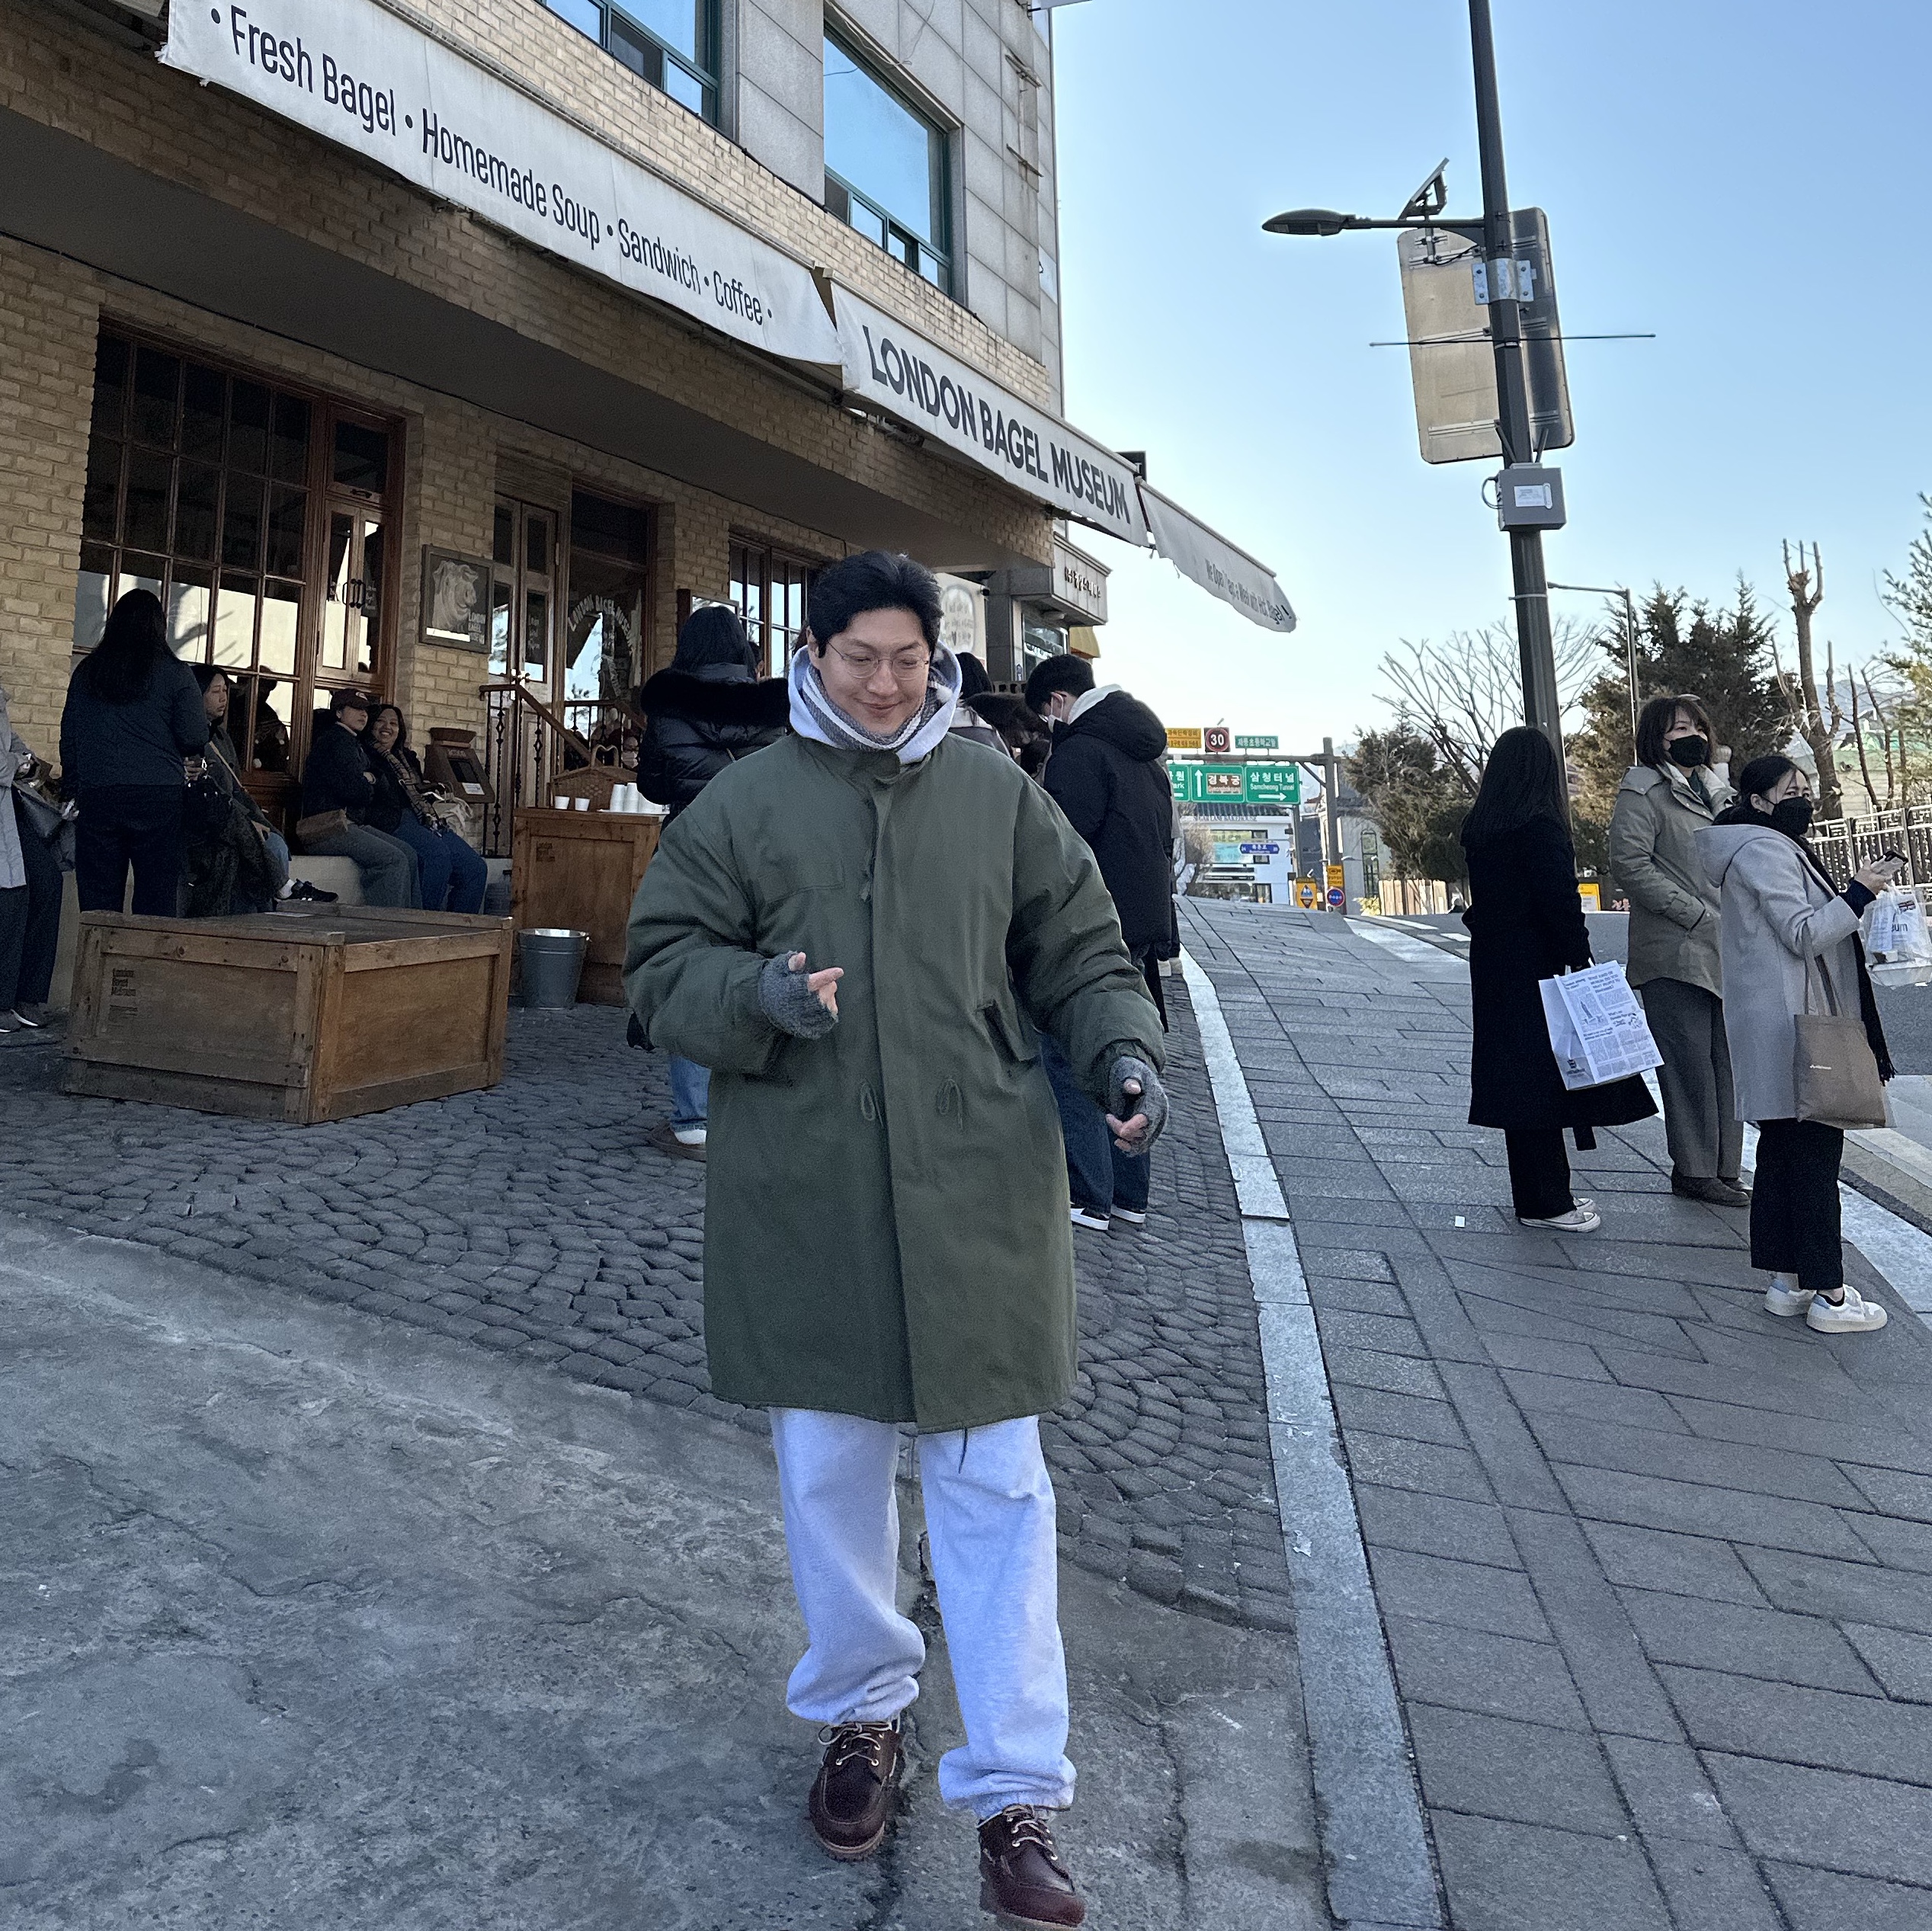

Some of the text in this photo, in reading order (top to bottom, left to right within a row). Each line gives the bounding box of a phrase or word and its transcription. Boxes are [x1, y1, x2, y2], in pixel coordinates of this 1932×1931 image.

[230, 5, 763, 326] Fresh Bagel Homemade Soup Sandwich Coffee
[862, 325, 1132, 524] LONDON BAGEL MUSEUM
[1210, 734, 1225, 746] 30
[1208, 774, 1241, 786] 경복궁
[1250, 772, 1294, 783] 삼청터널
